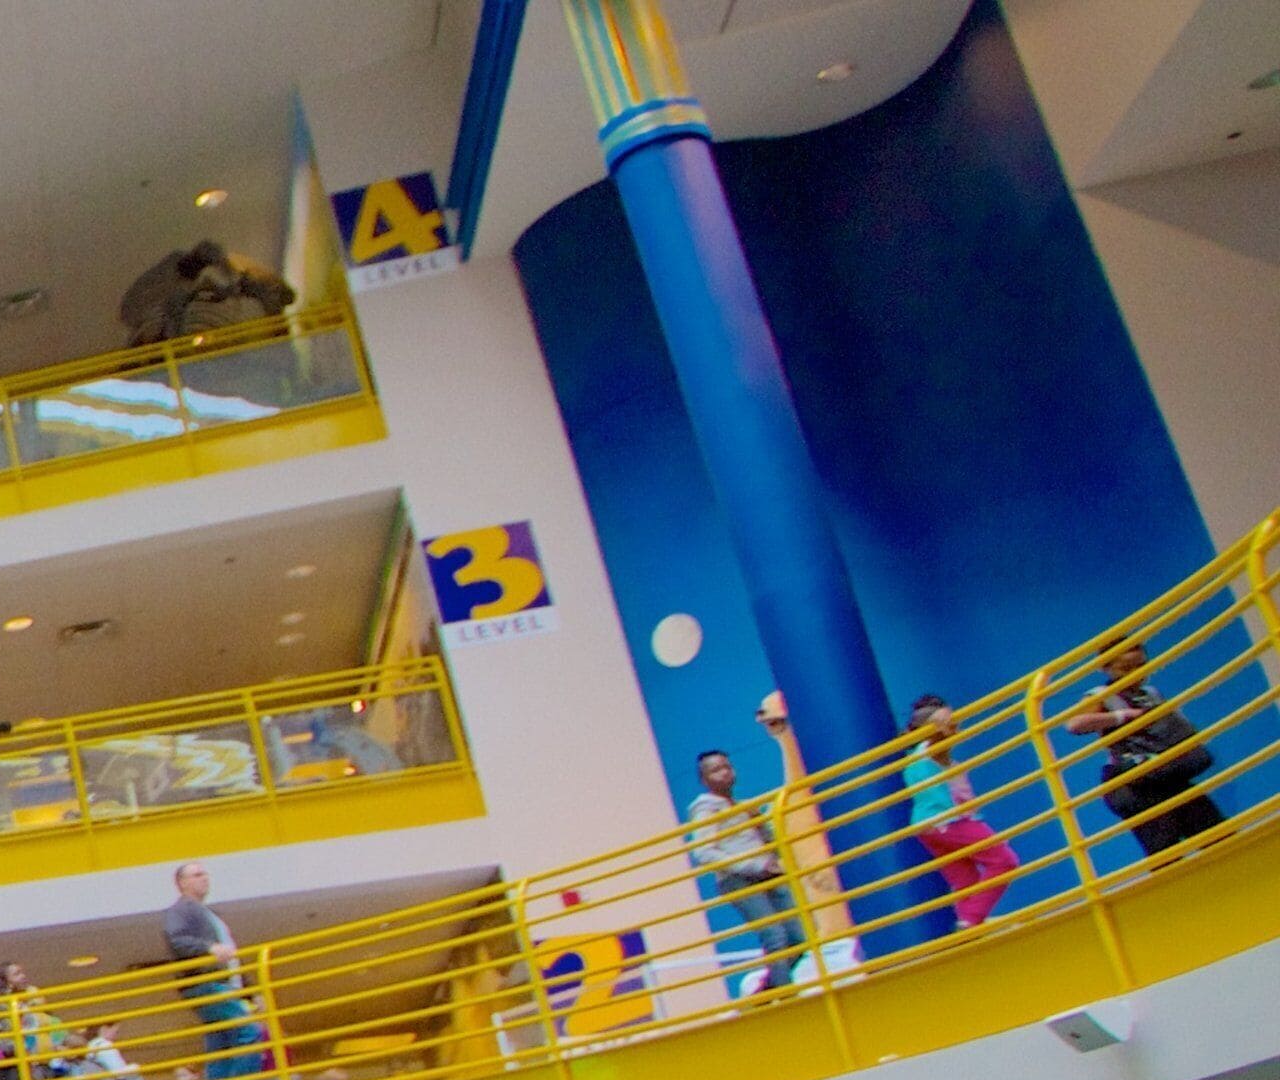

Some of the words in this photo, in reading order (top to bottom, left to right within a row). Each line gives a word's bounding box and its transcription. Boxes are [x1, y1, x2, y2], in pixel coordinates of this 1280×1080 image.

[351, 179, 445, 264] 4
[366, 255, 442, 282] LEVEL
[427, 525, 545, 621] 3
[460, 616, 543, 641] LEVEL
[534, 932, 654, 1037] 2
